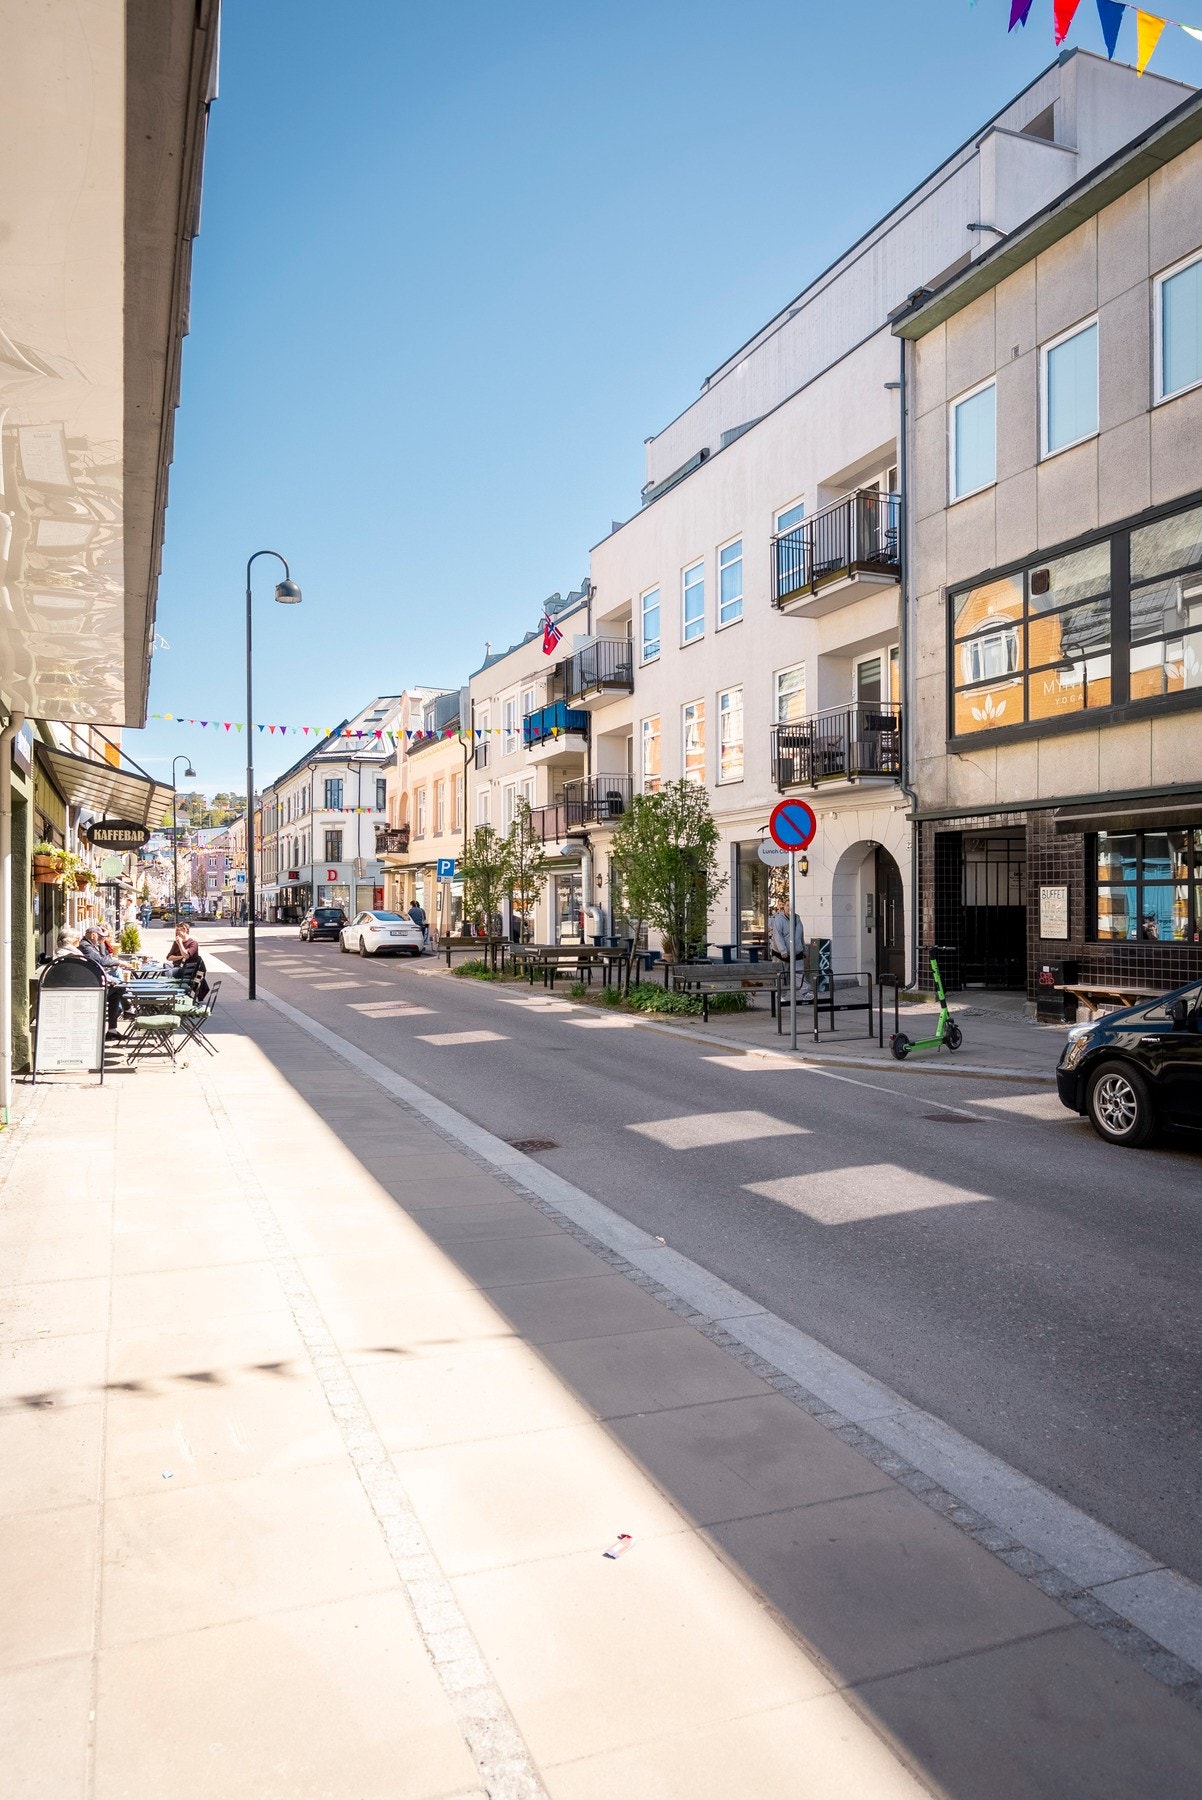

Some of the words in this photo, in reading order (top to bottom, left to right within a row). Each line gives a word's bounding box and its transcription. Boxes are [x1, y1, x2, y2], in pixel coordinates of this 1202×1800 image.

[1043, 676, 1094, 696] MYN
[1055, 694, 1083, 705] YOGA
[93, 830, 145, 841] KAFFEBAR
[441, 861, 451, 874] P
[327, 870, 337, 881] D
[1042, 889, 1065, 899] BUFFET
